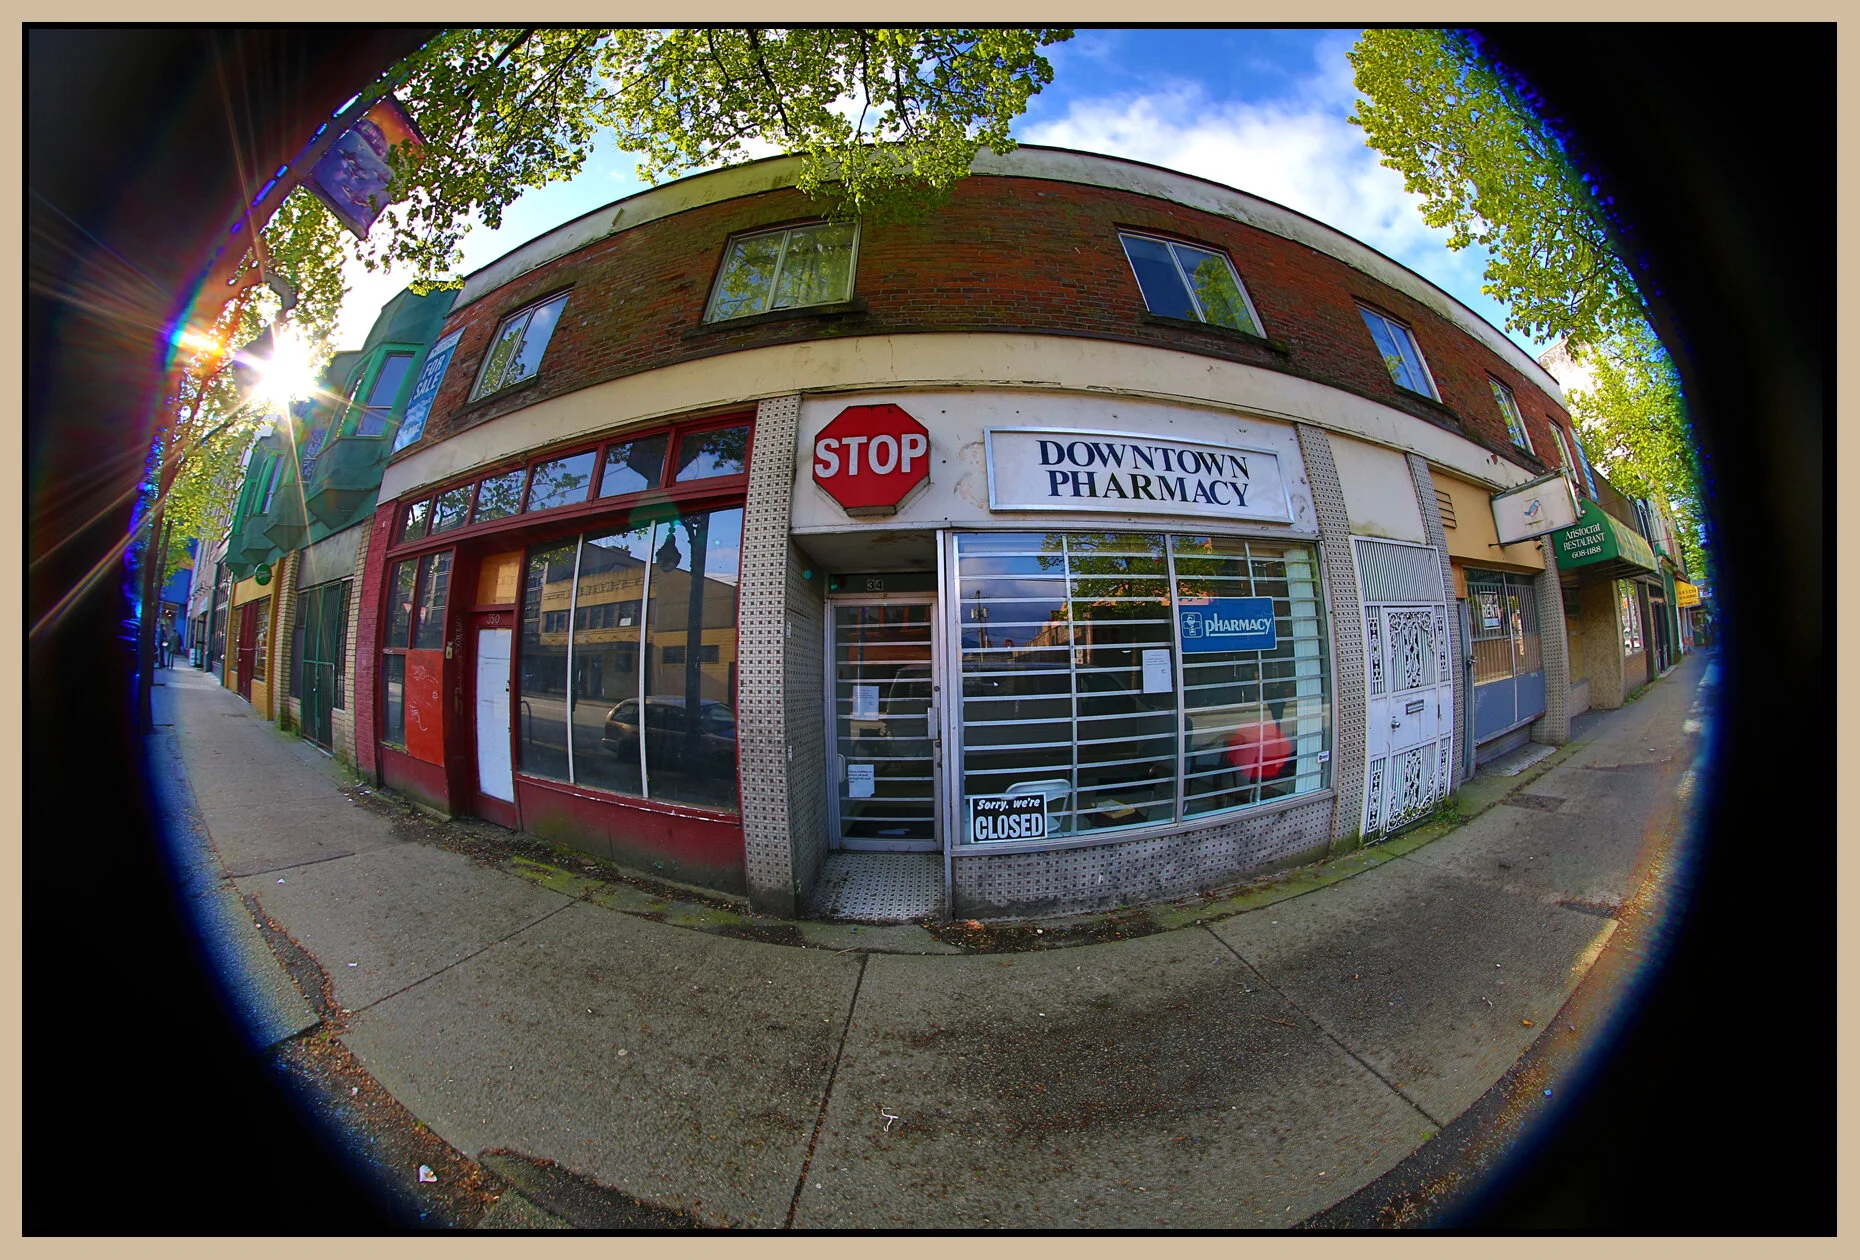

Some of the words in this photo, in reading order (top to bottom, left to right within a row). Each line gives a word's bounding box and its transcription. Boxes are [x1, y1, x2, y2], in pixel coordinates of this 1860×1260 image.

[421, 354, 446, 379] FOR
[413, 373, 440, 400] SALE
[814, 433, 928, 478] STOP
[1035, 440, 1250, 480] DOWNTOWN
[1045, 470, 1249, 507] PHARMACY
[1565, 522, 1601, 541] Aristocrat
[1563, 532, 1605, 551] RESTAURANT
[1571, 545, 1602, 559] 608-1188
[867, 580, 883, 590] 34
[487, 613, 500, 625] 350
[1482, 604, 1499, 618] RENT
[1013, 797, 1041, 809] we're
[975, 812, 1043, 840] CLOSED
